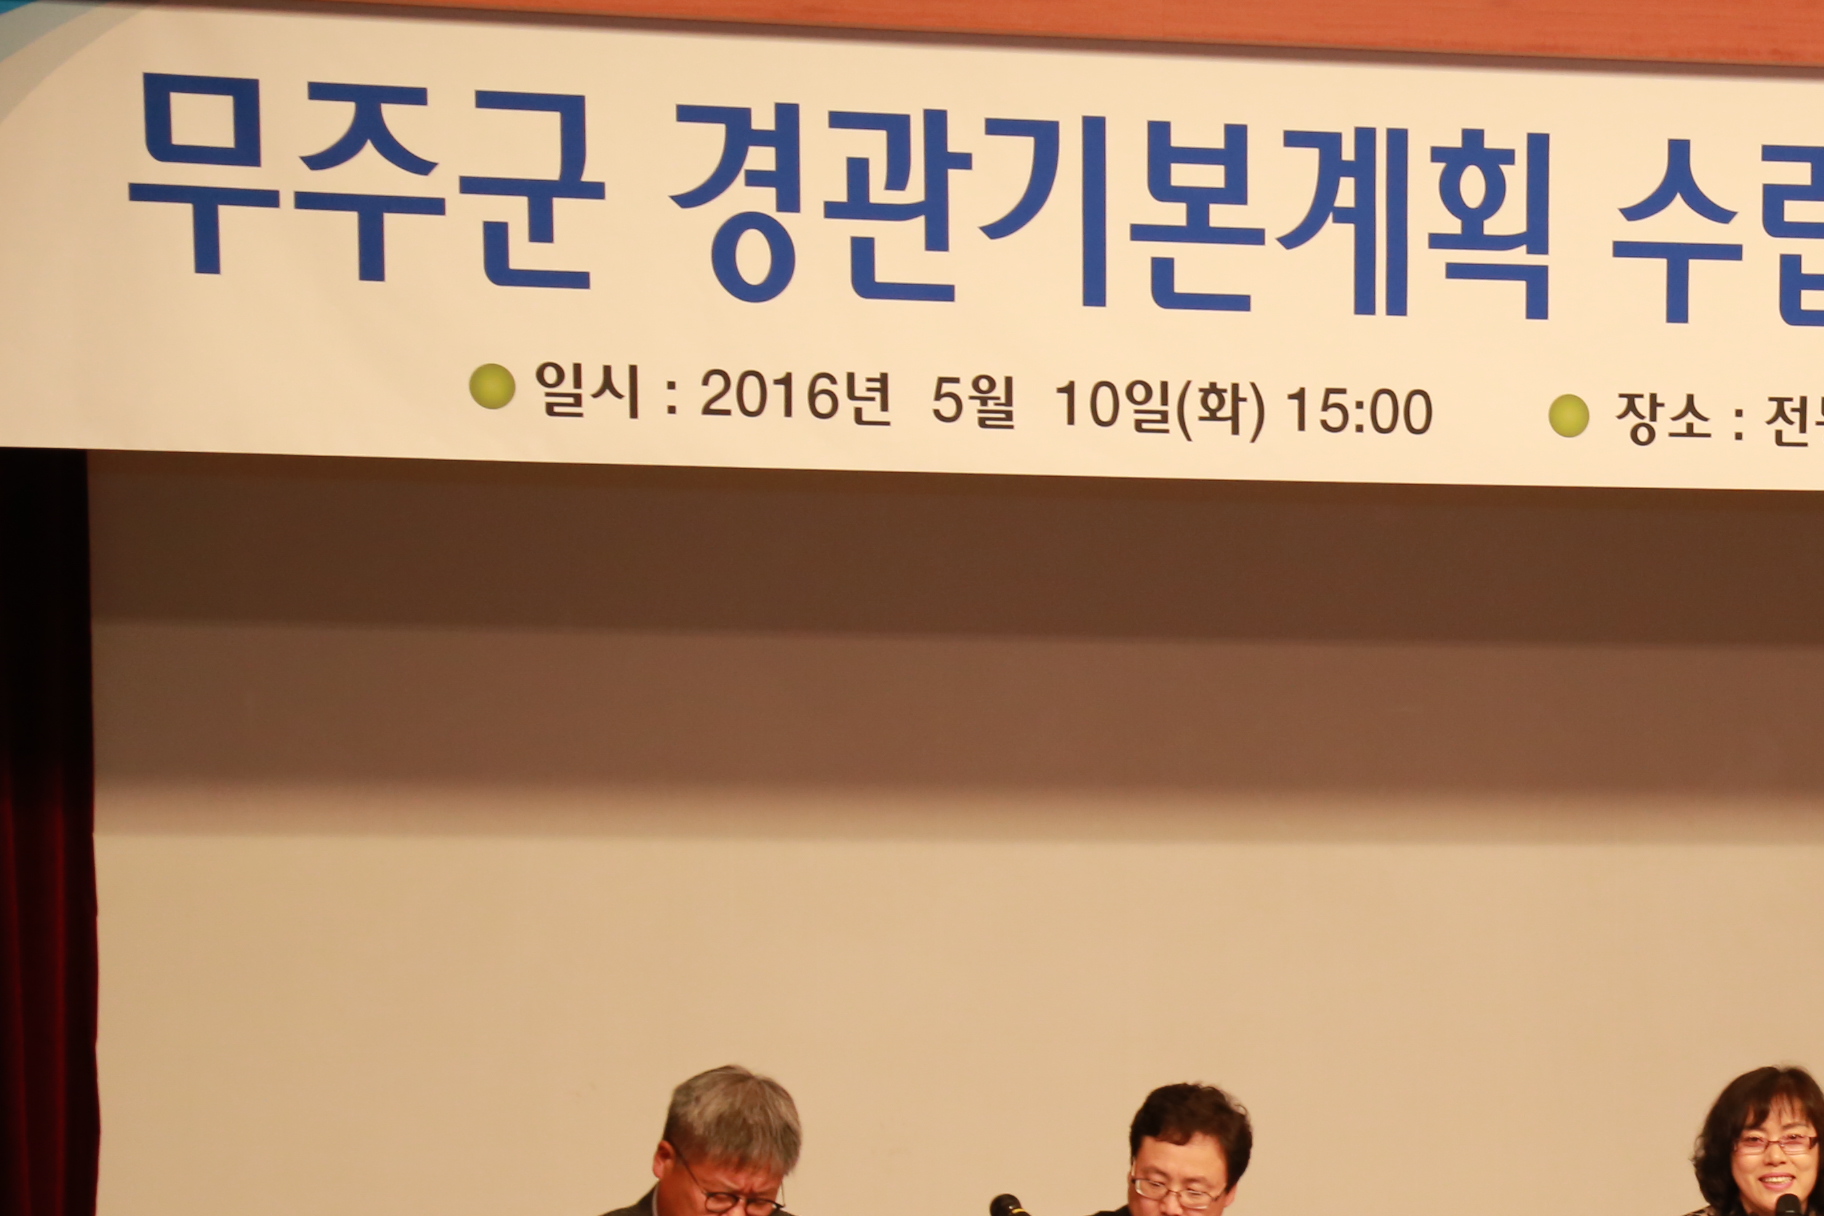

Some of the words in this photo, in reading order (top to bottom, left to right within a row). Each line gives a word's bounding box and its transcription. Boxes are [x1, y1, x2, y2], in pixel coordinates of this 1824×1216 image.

[127, 71, 606, 290] 무주군
[668, 102, 1550, 321] 경관기본계획
[535, 361, 639, 420] 일시
[701, 368, 891, 427] 2016년
[932, 374, 1015, 430] 5월
[1056, 379, 1265, 444] 10일(화)
[1287, 386, 1433, 436] 15:00
[1615, 392, 1712, 447] 장소
